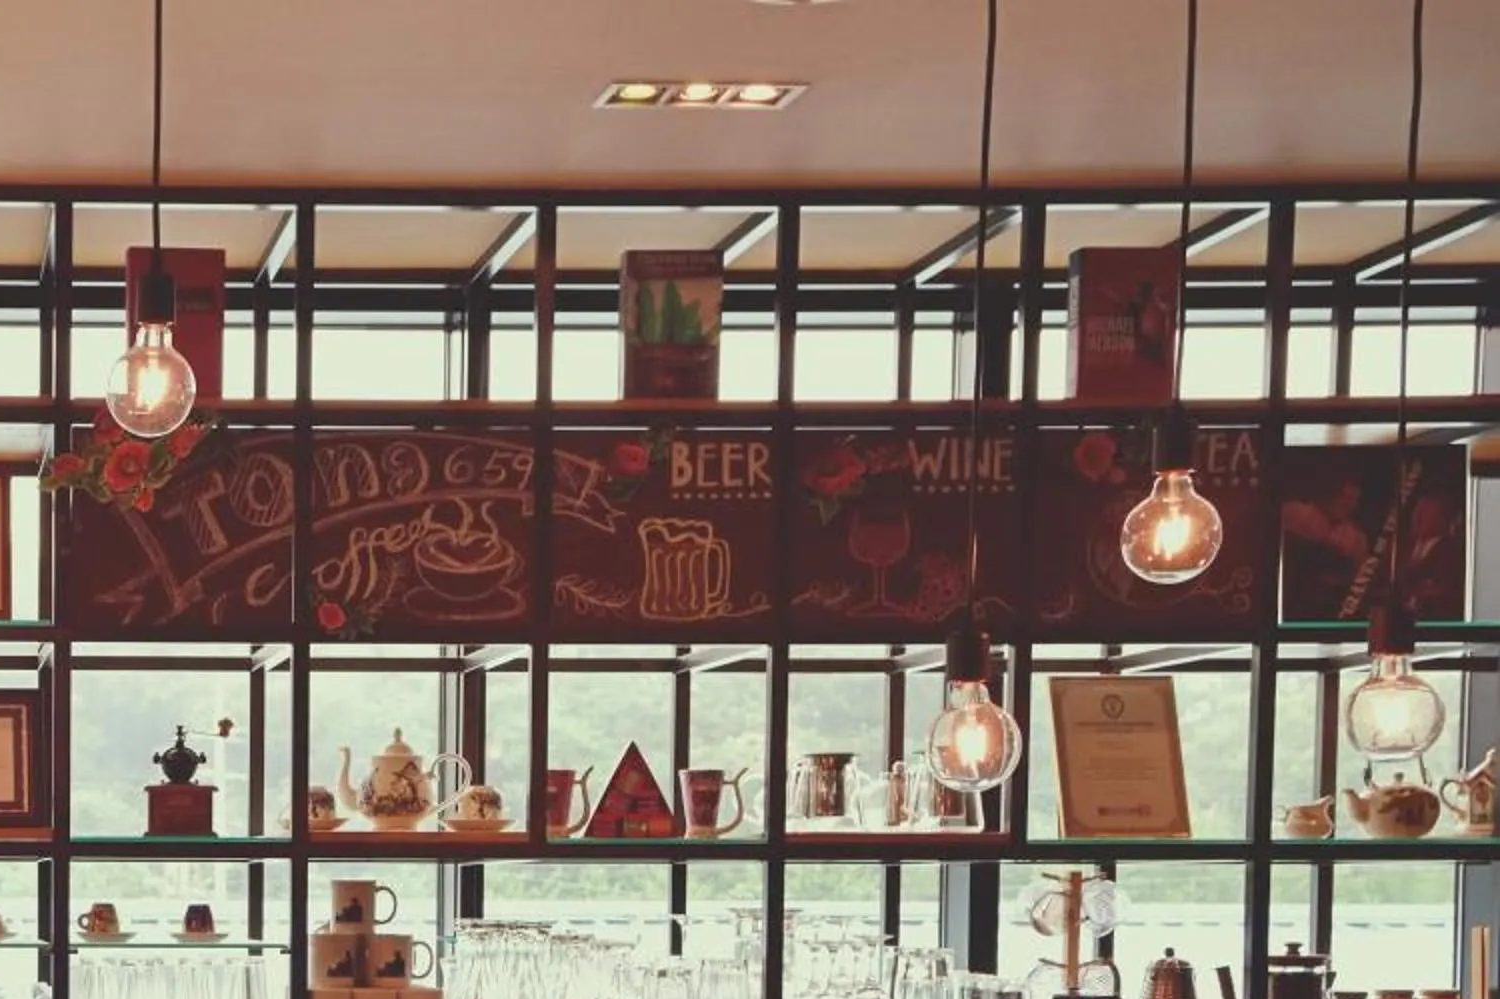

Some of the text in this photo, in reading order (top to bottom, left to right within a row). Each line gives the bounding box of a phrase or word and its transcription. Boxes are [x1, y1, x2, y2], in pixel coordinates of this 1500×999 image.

[443, 445, 535, 491] 659
[670, 441, 772, 488] BEER
[908, 436, 1014, 481] WINE
